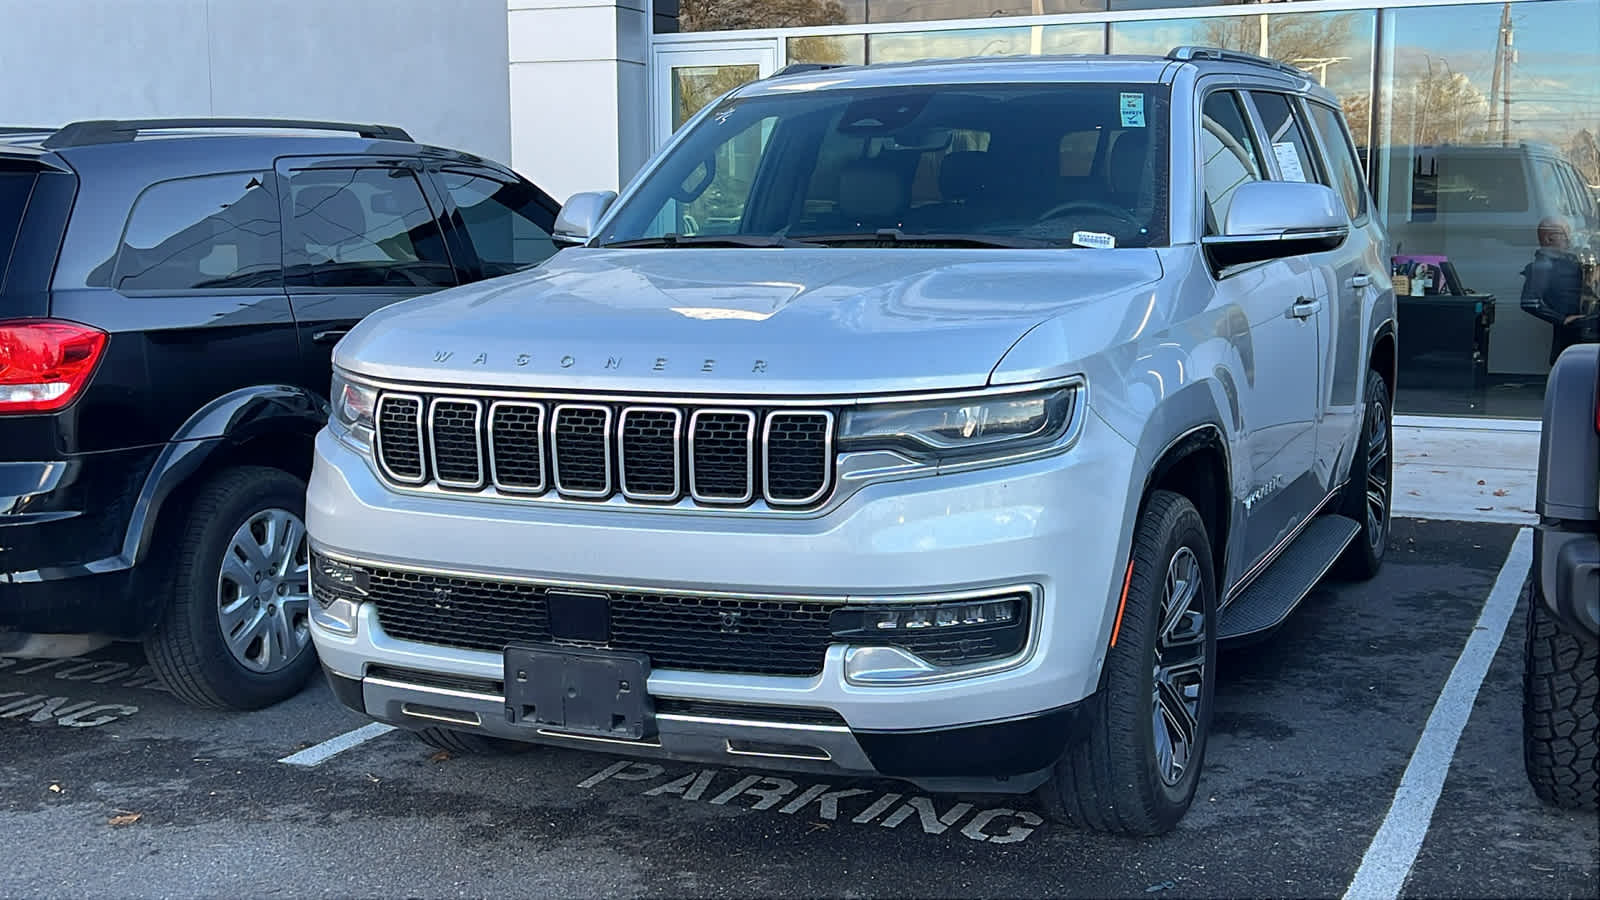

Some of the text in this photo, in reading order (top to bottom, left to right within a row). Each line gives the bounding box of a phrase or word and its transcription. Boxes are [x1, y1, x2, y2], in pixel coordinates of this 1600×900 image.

[433, 350, 768, 373] WAGONEER
[0, 692, 139, 727] ING
[577, 761, 1044, 844] PARKING
